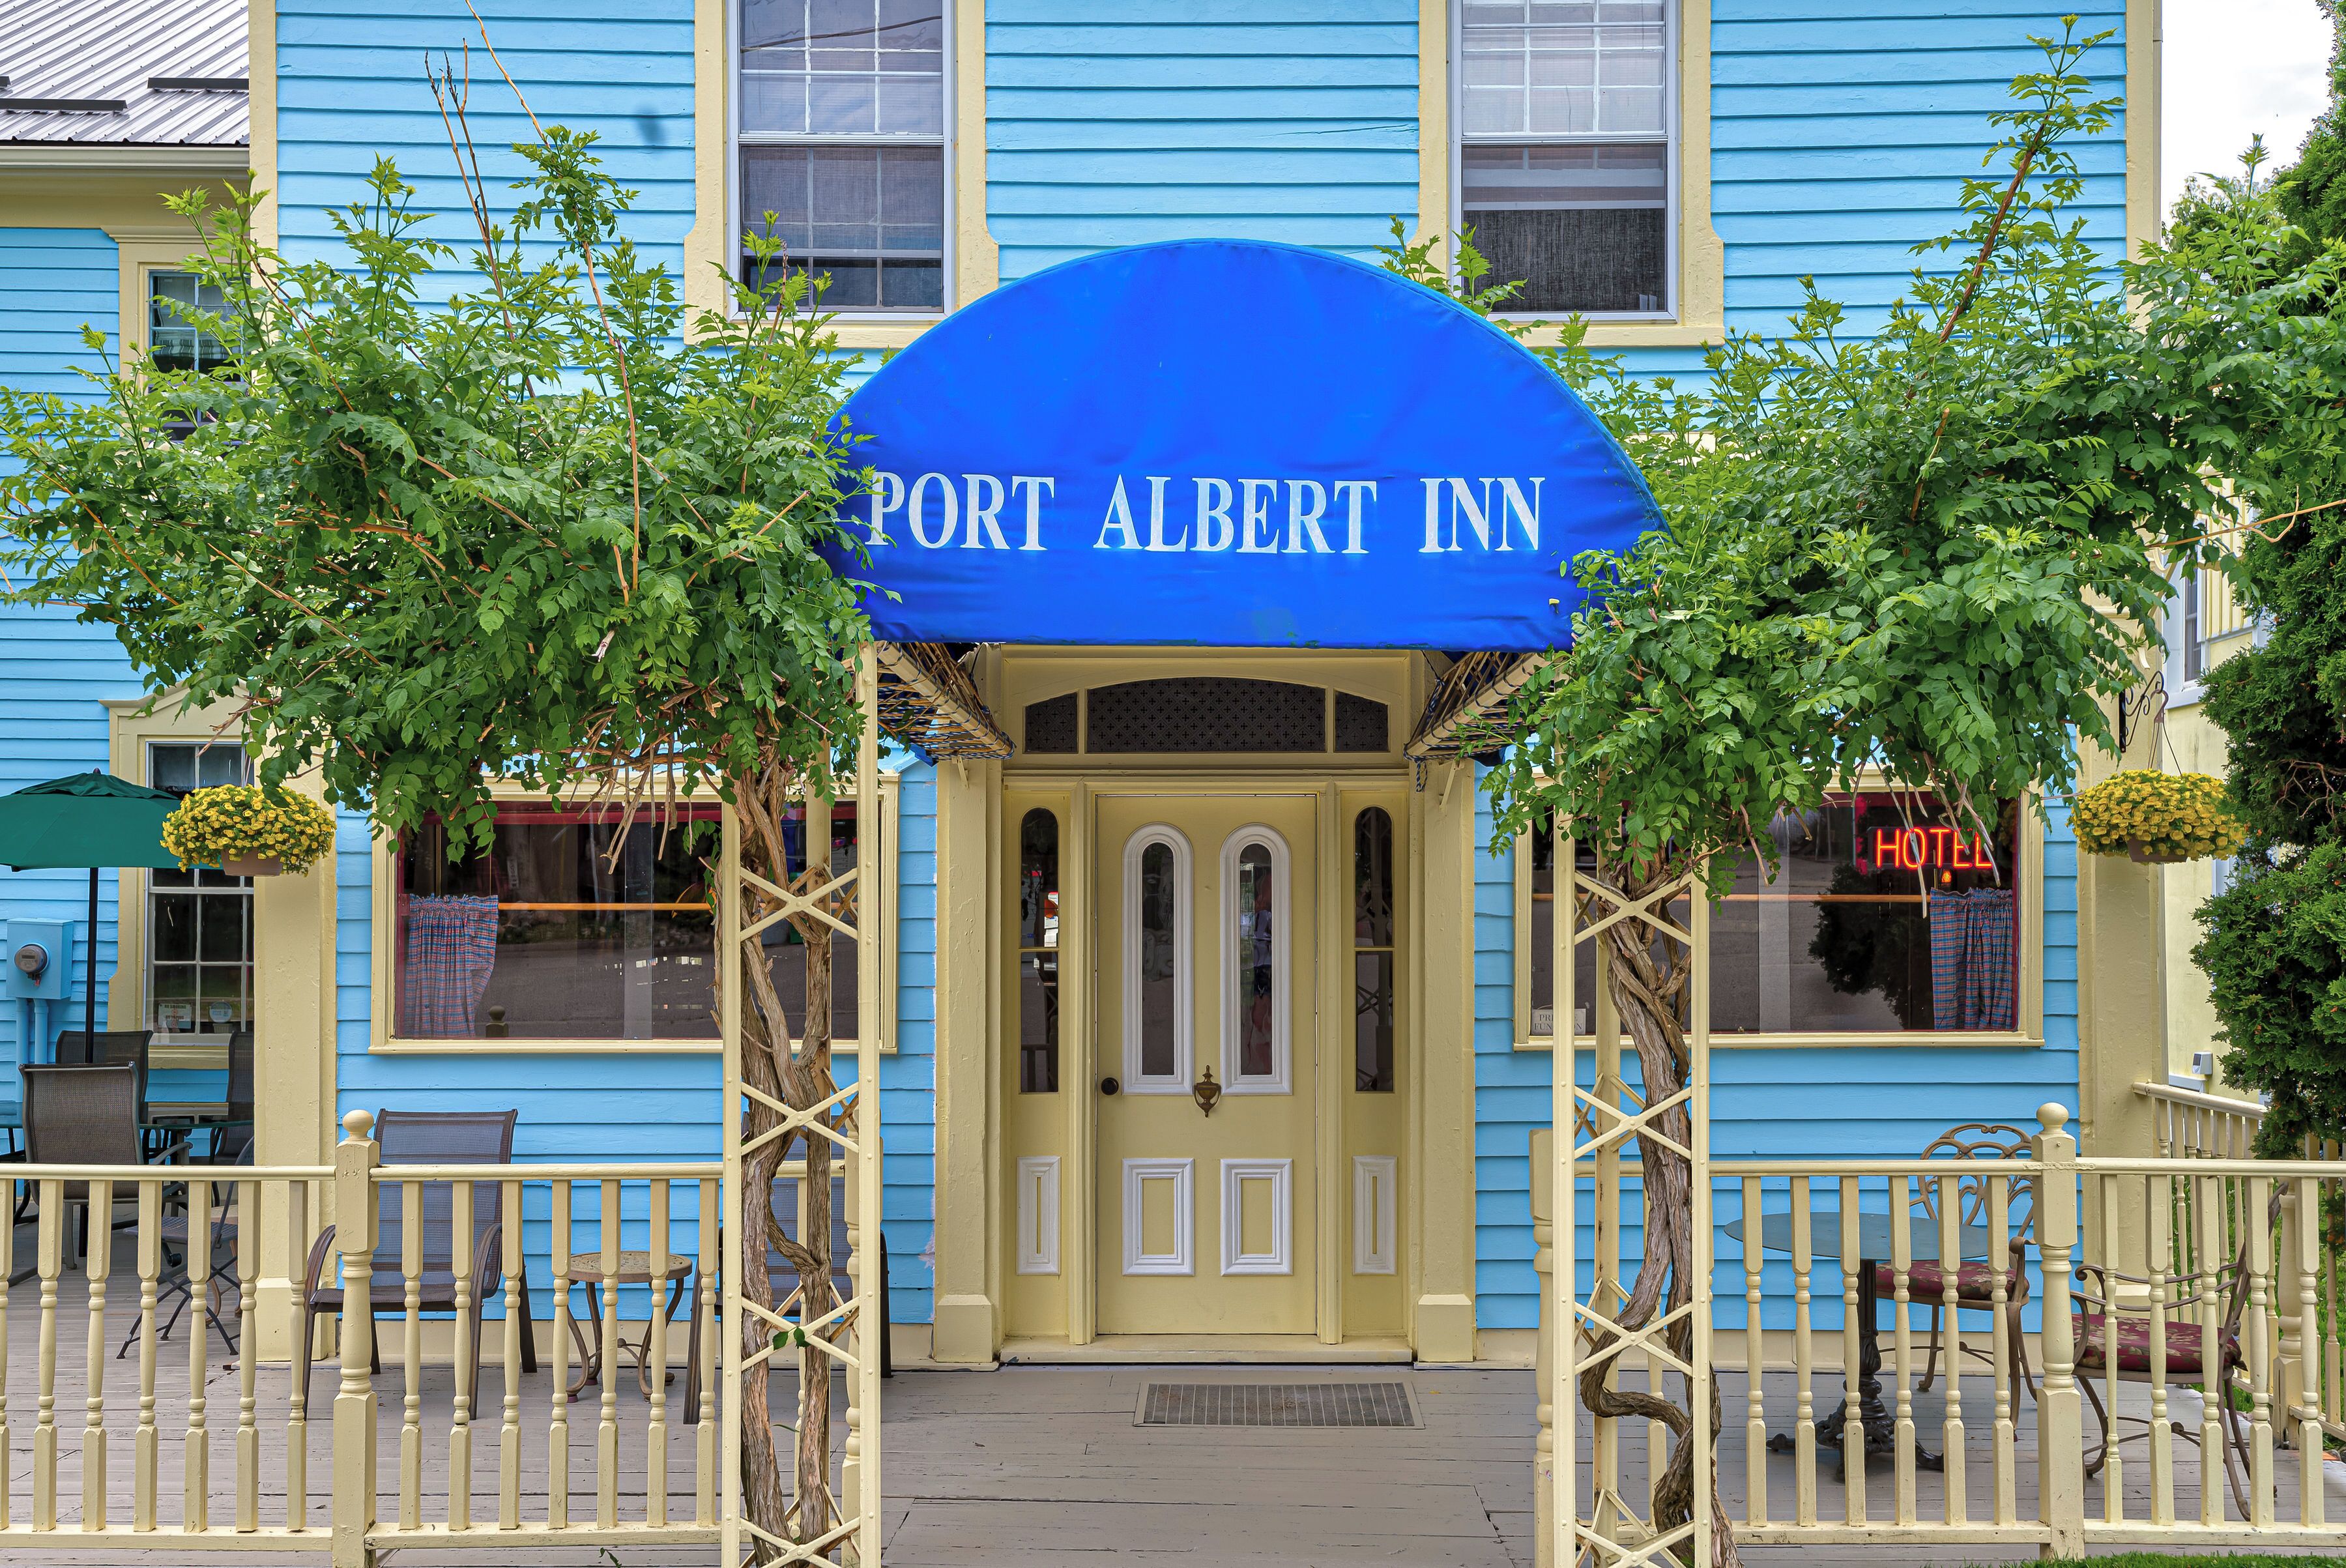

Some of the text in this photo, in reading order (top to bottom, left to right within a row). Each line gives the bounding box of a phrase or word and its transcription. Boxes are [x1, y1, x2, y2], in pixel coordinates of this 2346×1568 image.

[865, 471, 1546, 554] PORT ALBERT INN
[1875, 827, 1993, 869] HOTEL
